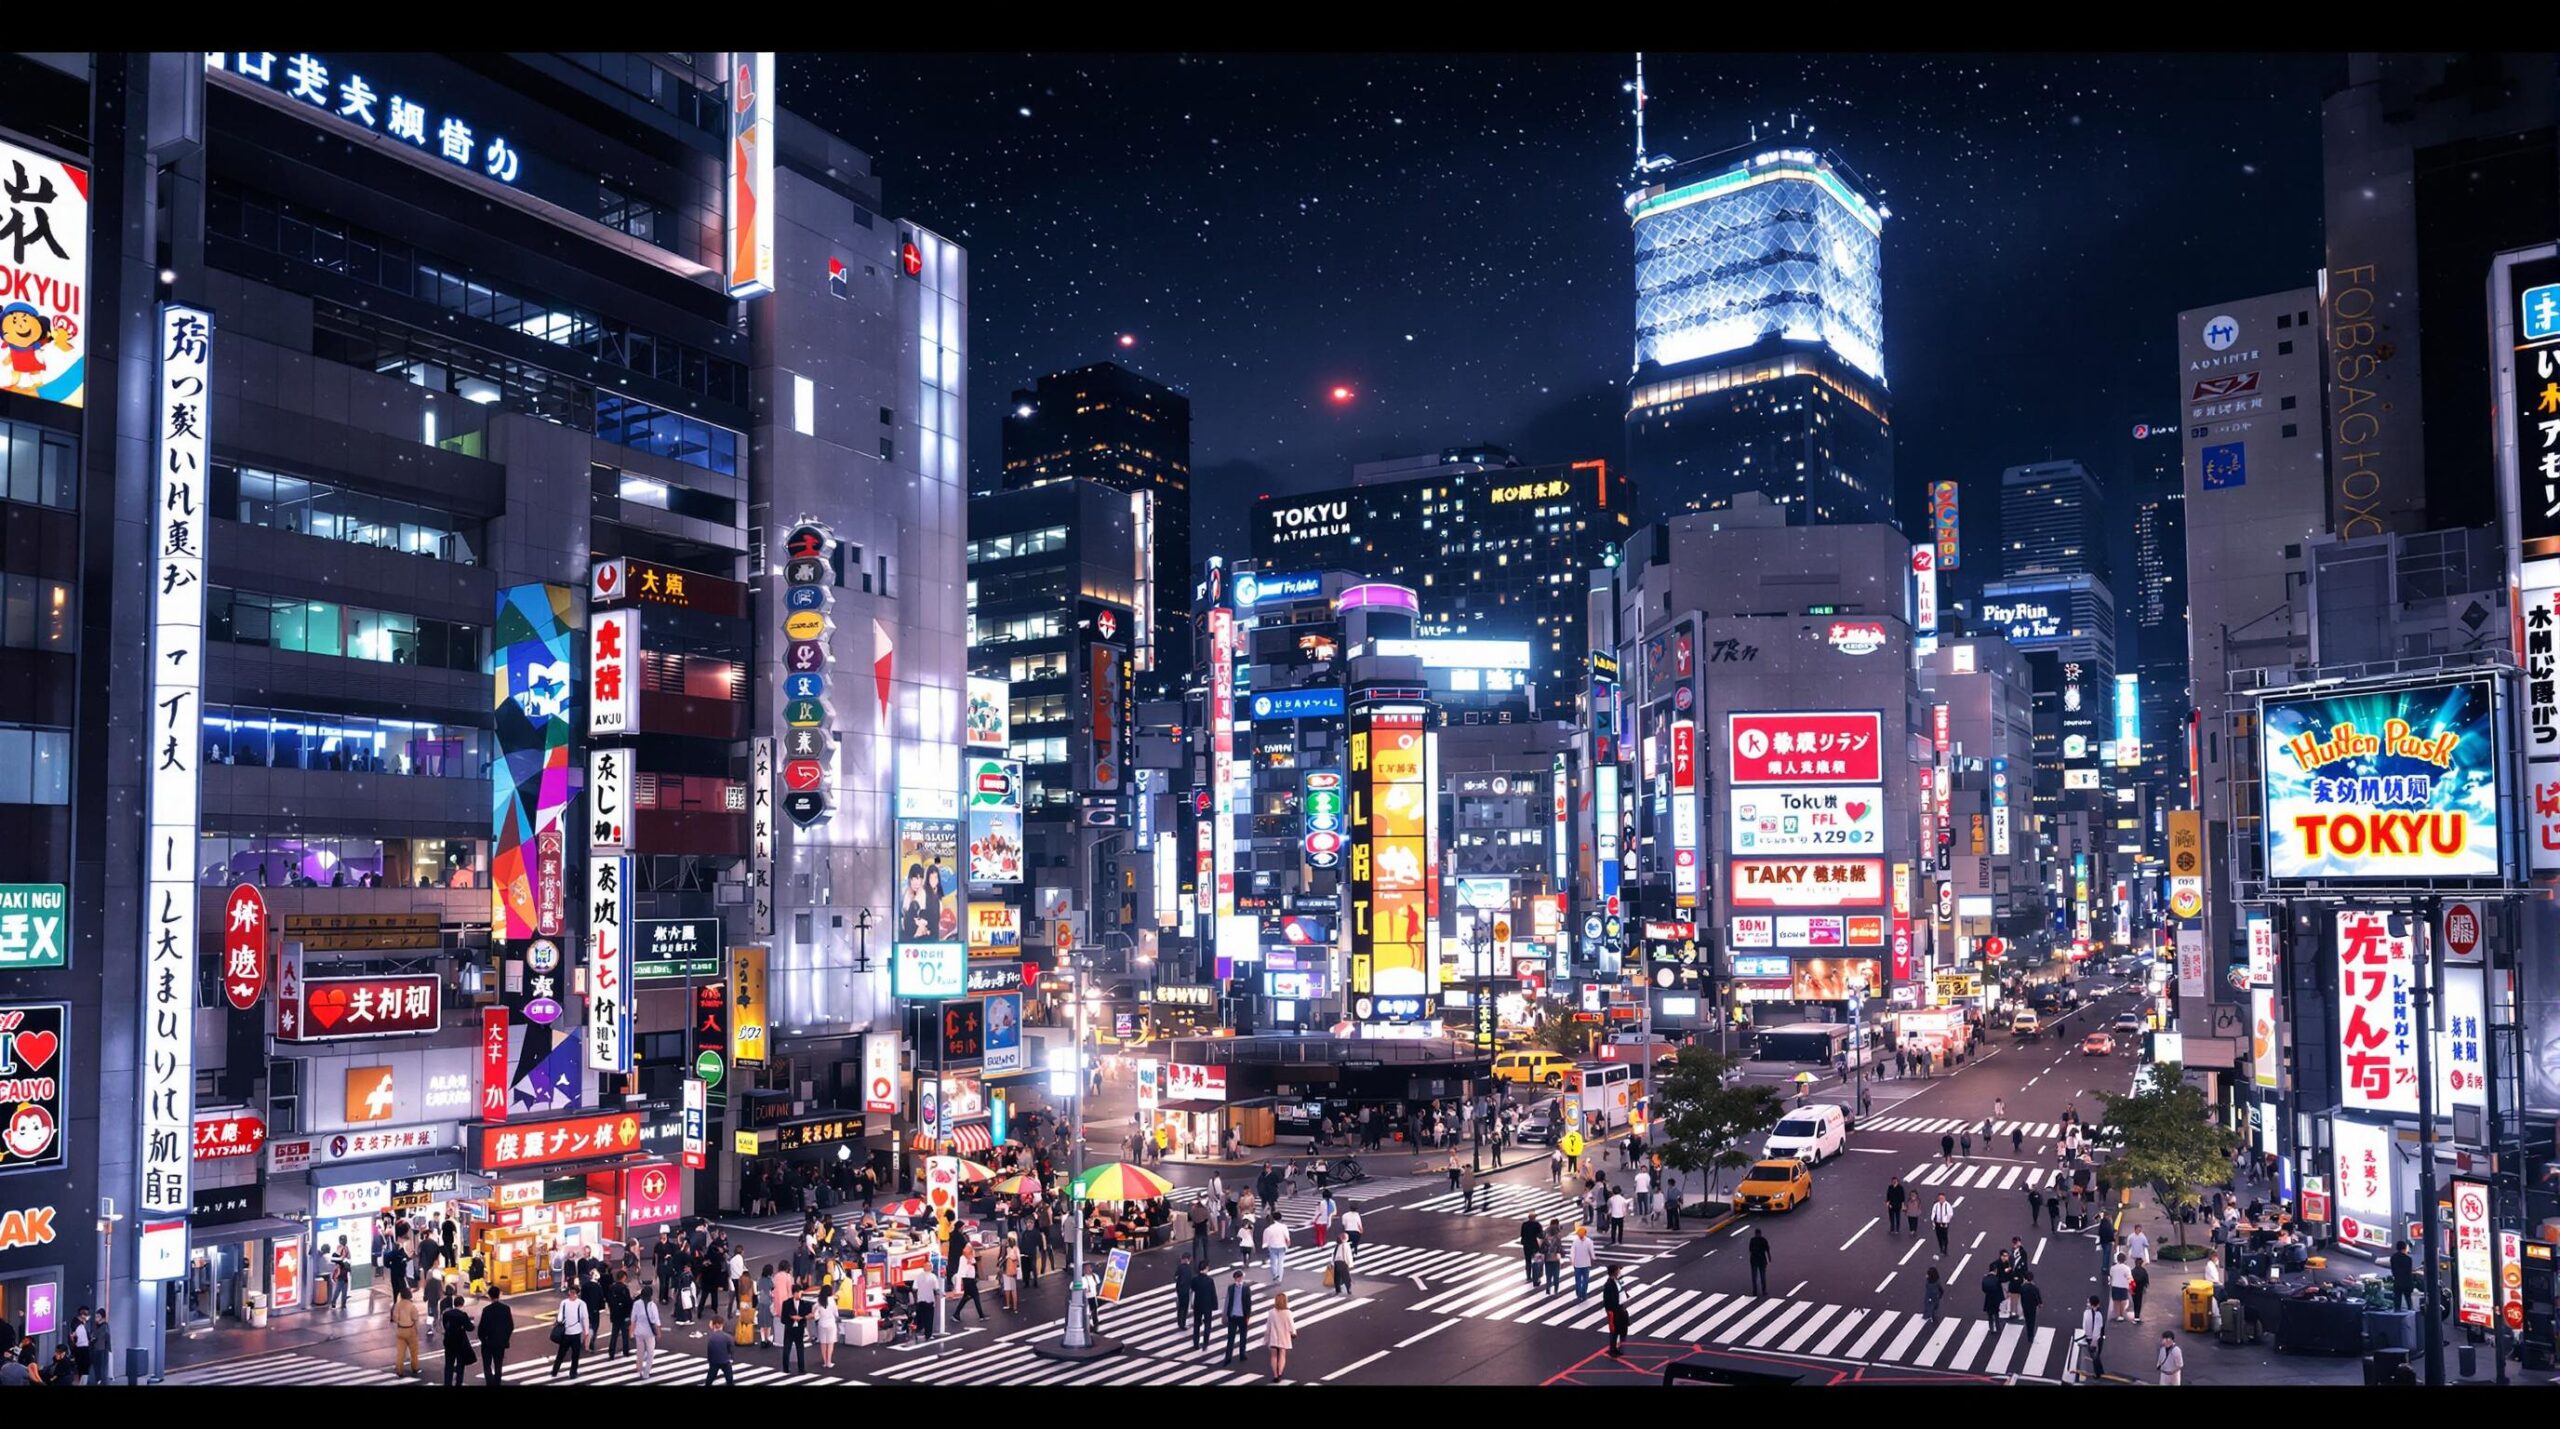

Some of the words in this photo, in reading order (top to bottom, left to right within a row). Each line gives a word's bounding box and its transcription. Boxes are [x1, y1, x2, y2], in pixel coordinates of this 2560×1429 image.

[1272, 501, 1347, 528] TOKYU
[2296, 814, 2462, 855] TOKYU
[1745, 865, 1808, 883] TAKY
[32, 891, 61, 909] NGU
